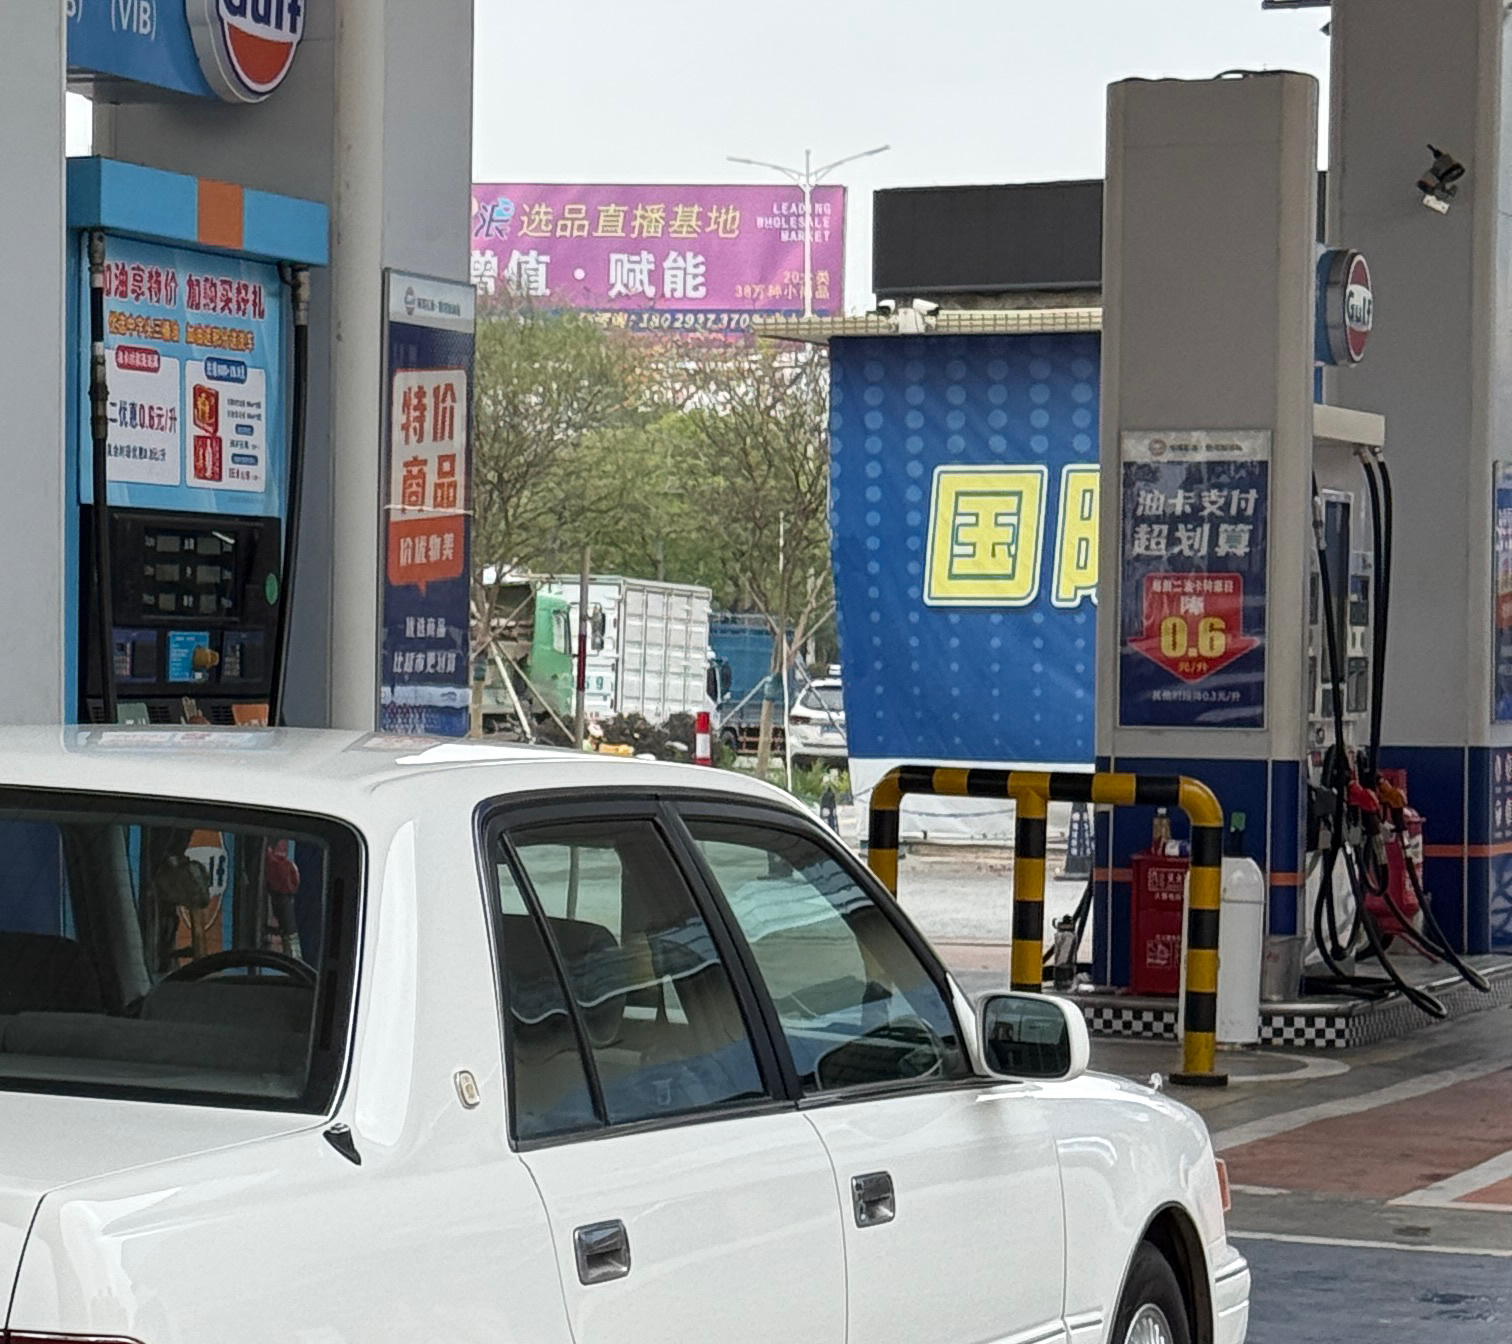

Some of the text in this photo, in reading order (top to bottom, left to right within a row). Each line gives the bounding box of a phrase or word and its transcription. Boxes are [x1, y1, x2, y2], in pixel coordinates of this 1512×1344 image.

[518, 202, 740, 240] 选品直播基地
[772, 202, 831, 215] LEADNG
[783, 270, 829, 285] 20类
[1347, 289, 1372, 325] Gulf
[401, 383, 457, 445] 特价
[402, 453, 457, 513] 商品
[1136, 488, 1259, 517] 油卡支付
[1132, 523, 1254, 557] 超划算
[1160, 616, 1226, 658] 0.6
